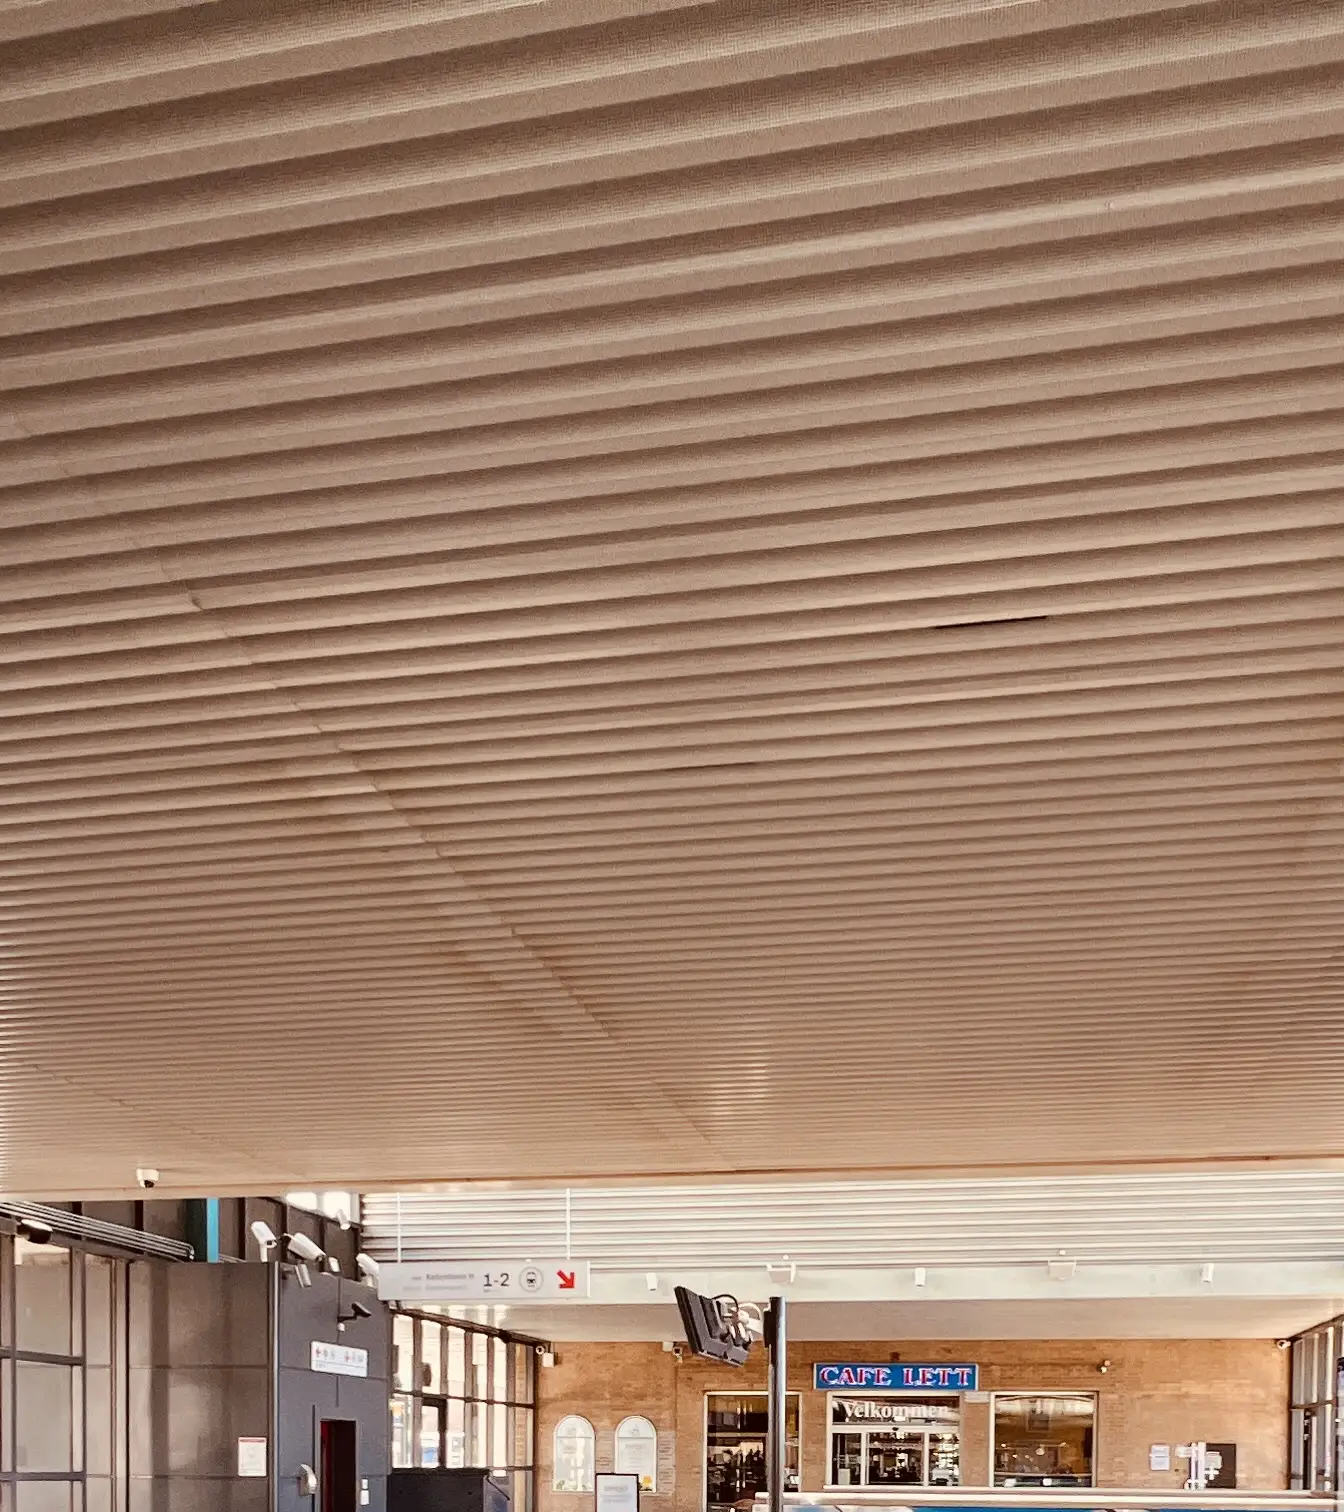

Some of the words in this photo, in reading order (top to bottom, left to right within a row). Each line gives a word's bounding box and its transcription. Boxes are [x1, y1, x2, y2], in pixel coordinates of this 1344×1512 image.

[483, 1272, 510, 1287] 1-2
[820, 1366, 892, 1387] CAFE
[902, 1367, 972, 1387] LETT
[843, 1401, 949, 1418] Velkommen
